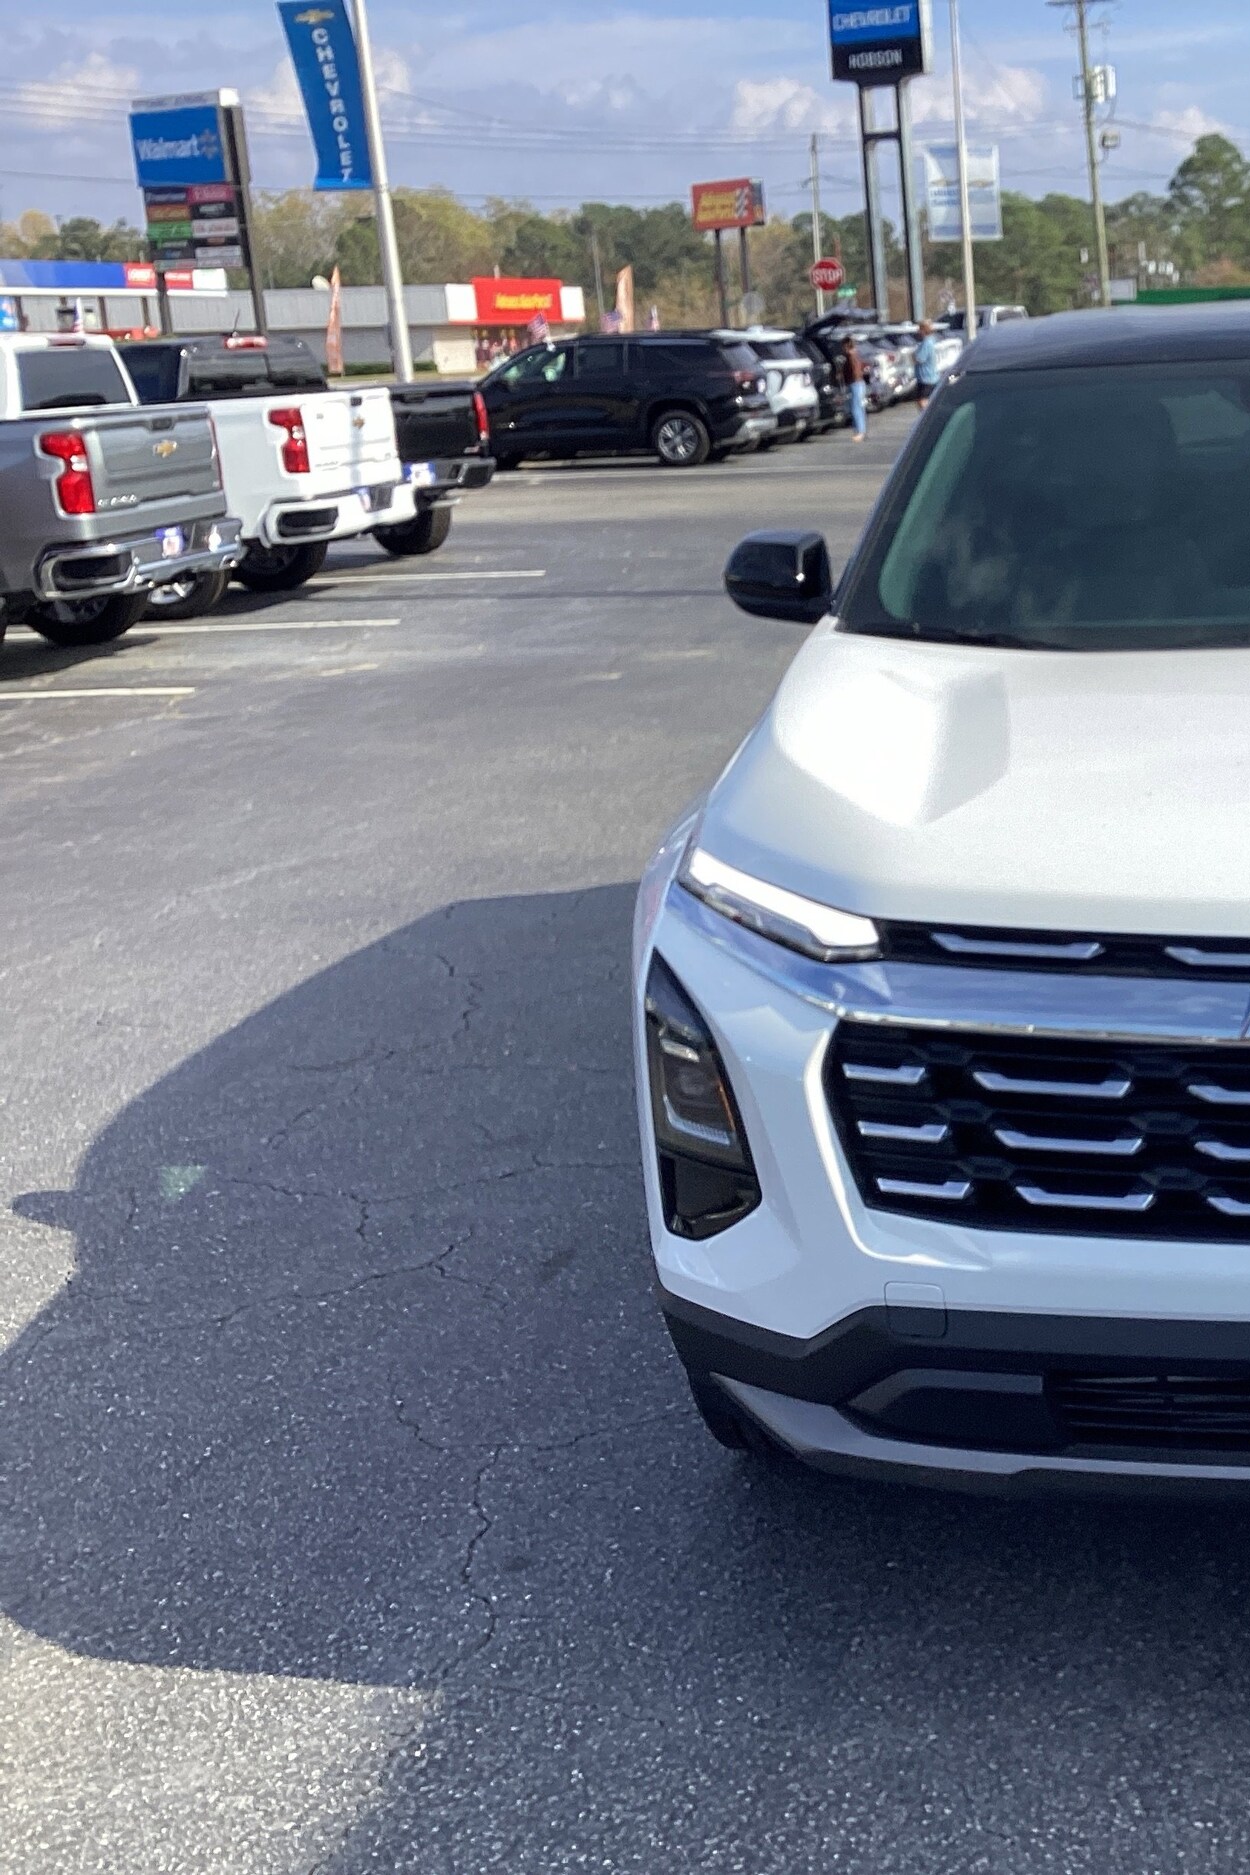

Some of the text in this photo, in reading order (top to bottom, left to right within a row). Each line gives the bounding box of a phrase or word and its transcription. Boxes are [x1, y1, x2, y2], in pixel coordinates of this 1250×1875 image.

[832, 2, 913, 33] CHEVROLET
[848, 48, 903, 70] HOBSON
[311, 27, 353, 183] CHEVROLET
[136, 133, 200, 161] Walmart
[812, 268, 843, 284] STOP
